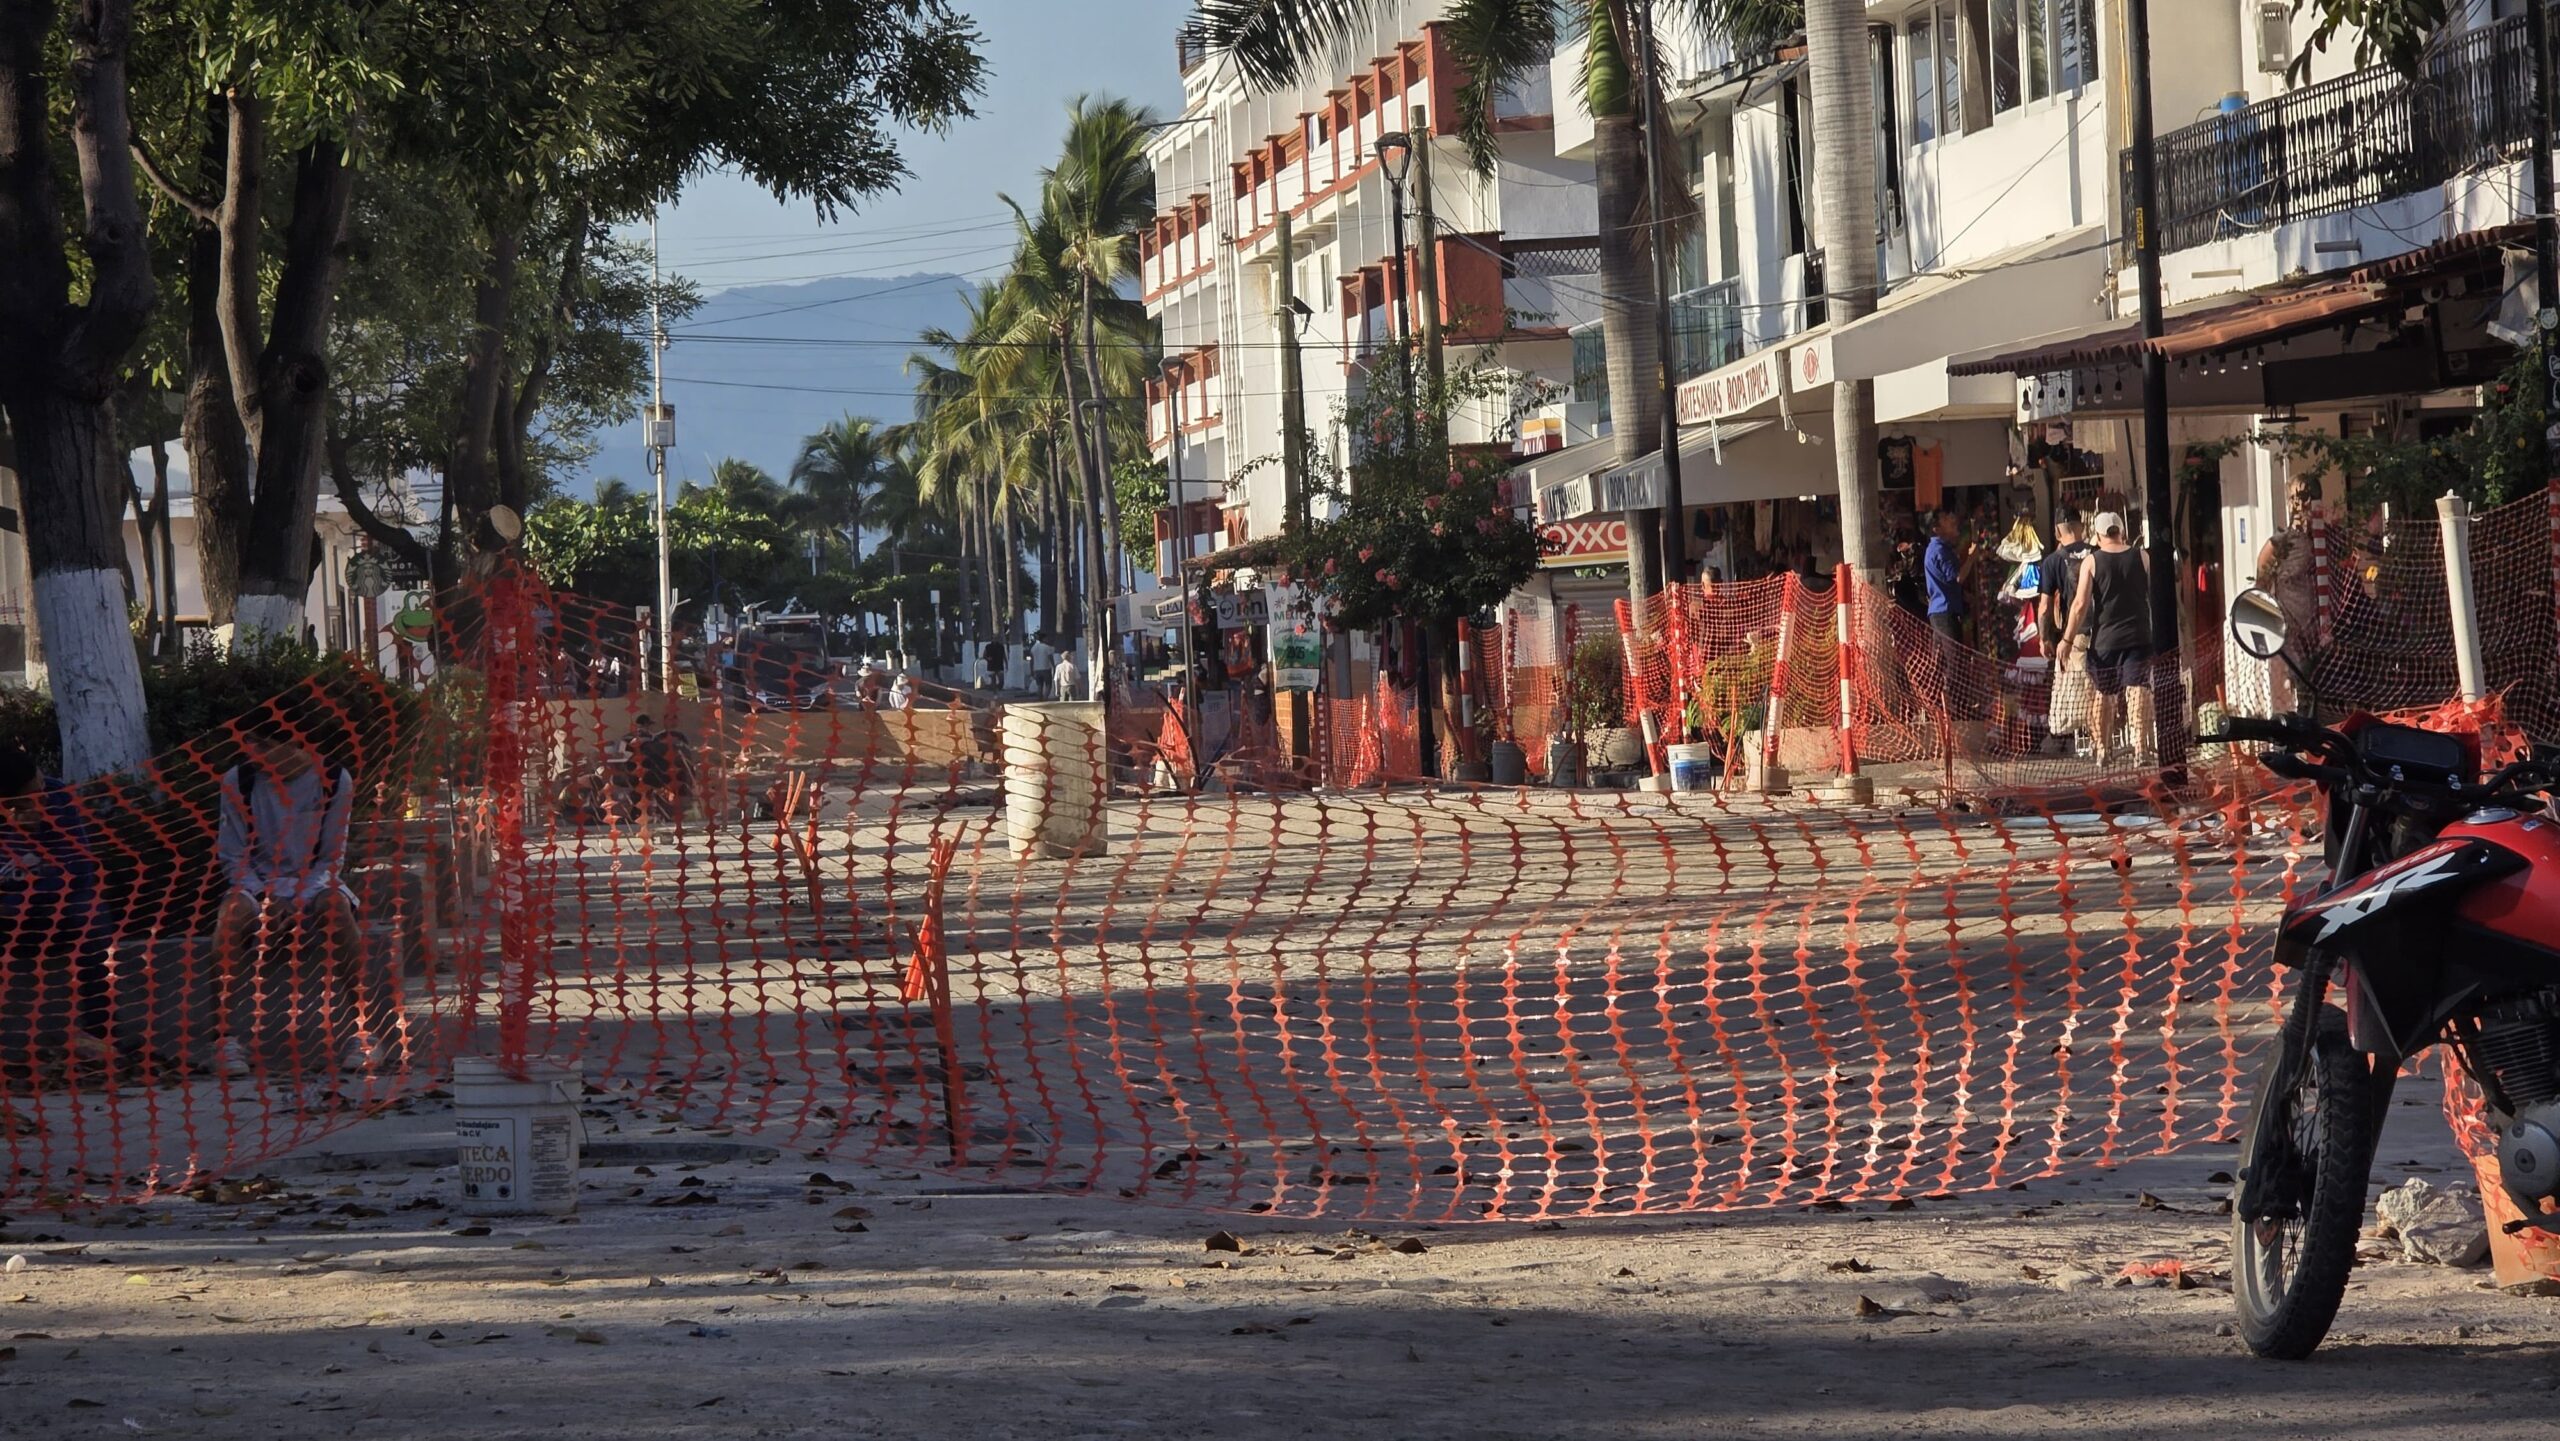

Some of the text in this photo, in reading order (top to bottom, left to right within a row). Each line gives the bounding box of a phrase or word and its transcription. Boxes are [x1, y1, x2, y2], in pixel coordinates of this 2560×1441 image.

[1680, 379, 1722, 422] ARTESANIAS
[1727, 373, 1748, 412] ROPA
[1543, 520, 1629, 556] OXXO
[1274, 610, 1314, 621] MEXIC
